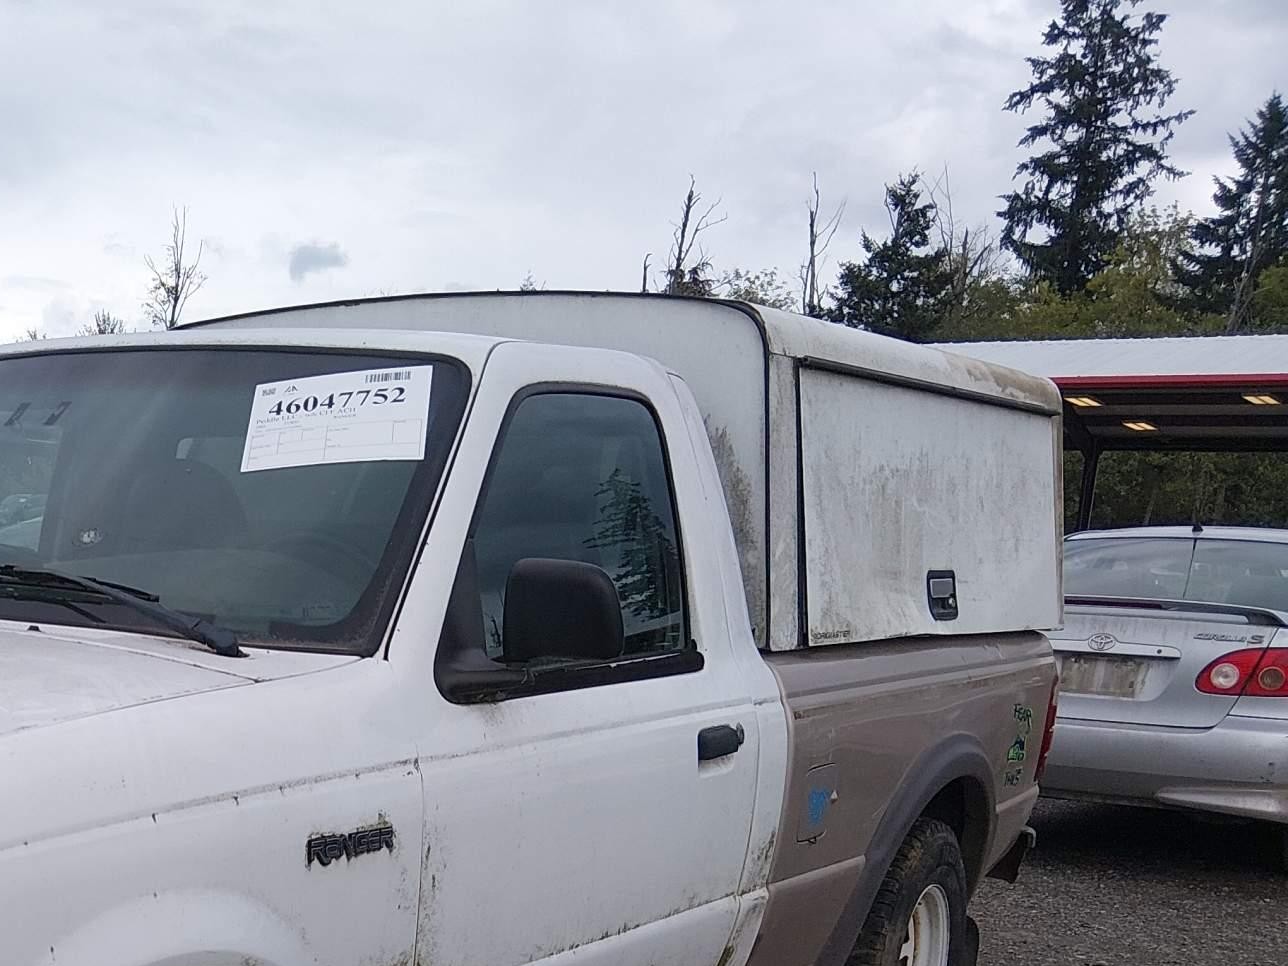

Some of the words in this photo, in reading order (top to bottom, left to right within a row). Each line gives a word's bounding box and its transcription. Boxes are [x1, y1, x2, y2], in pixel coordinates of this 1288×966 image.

[268, 387, 406, 416] 46047752
[1247, 634, 1266, 645] S
[306, 826, 395, 866] RANGER
